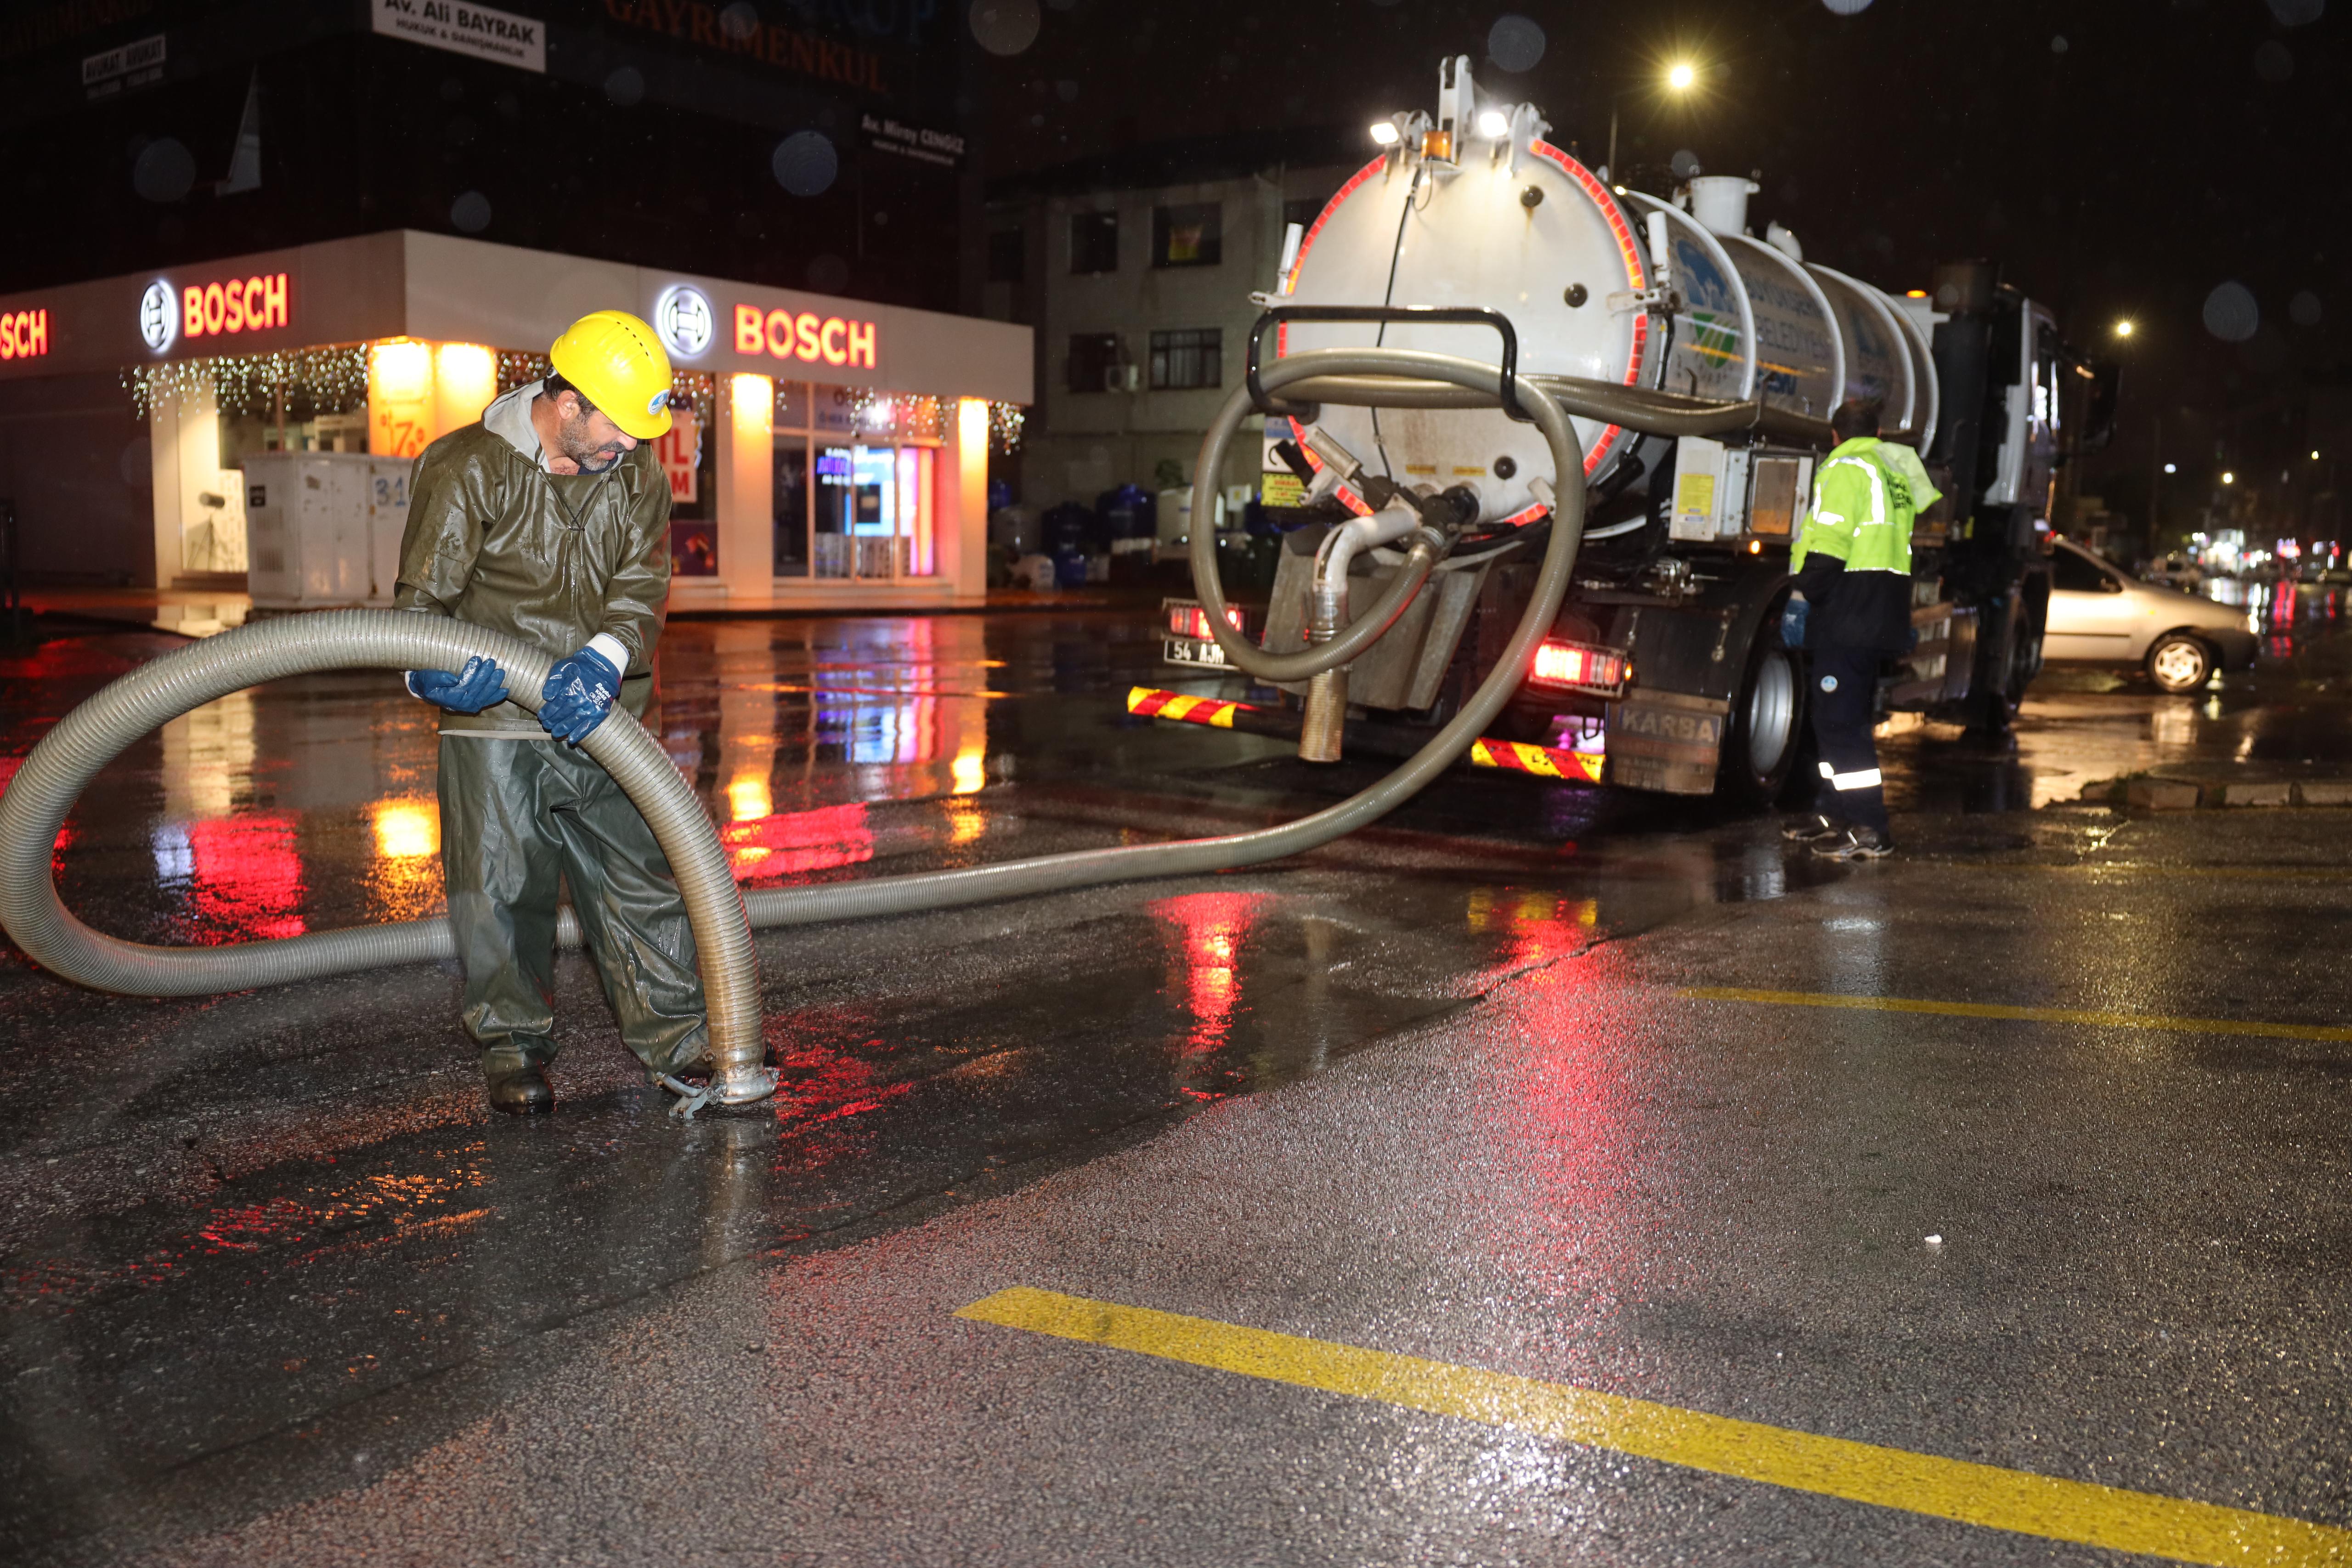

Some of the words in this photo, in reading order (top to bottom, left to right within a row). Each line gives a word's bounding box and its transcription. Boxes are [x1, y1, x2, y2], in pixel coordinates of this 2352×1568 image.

[396, 18, 437, 36] HUKUK
[440, 28, 448, 40] &
[424, 1, 450, 23] Ali
[458, 9, 535, 45] BAYRAK
[183, 273, 288, 338] BOSCH
[0, 309, 48, 360] SCH
[734, 303, 876, 369] BOSCH
[1174, 641, 1192, 661] 54
